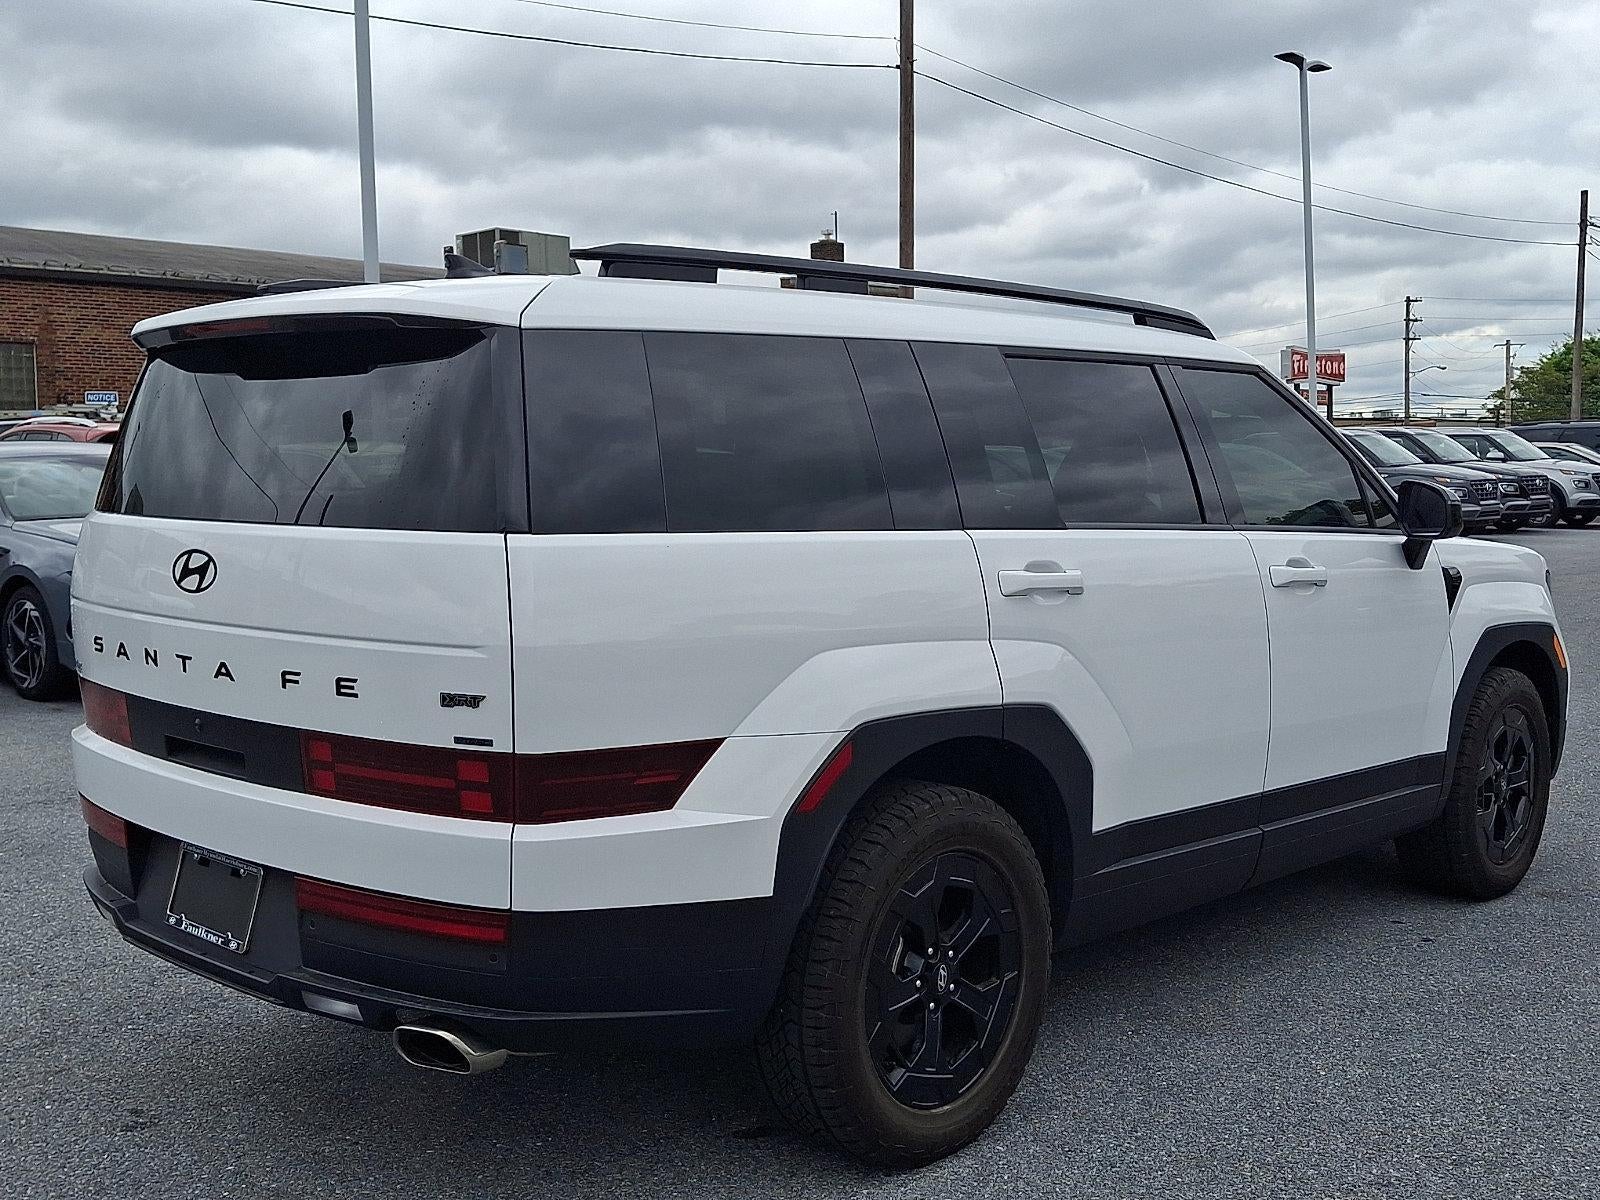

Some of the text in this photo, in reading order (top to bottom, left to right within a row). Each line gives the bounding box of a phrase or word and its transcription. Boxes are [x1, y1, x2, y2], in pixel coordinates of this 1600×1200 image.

[1292, 354, 1344, 375] Firstone
[93, 635, 359, 699] SANTA FE
[440, 692, 487, 709] XRT
[180, 920, 225, 946] Faulkner
